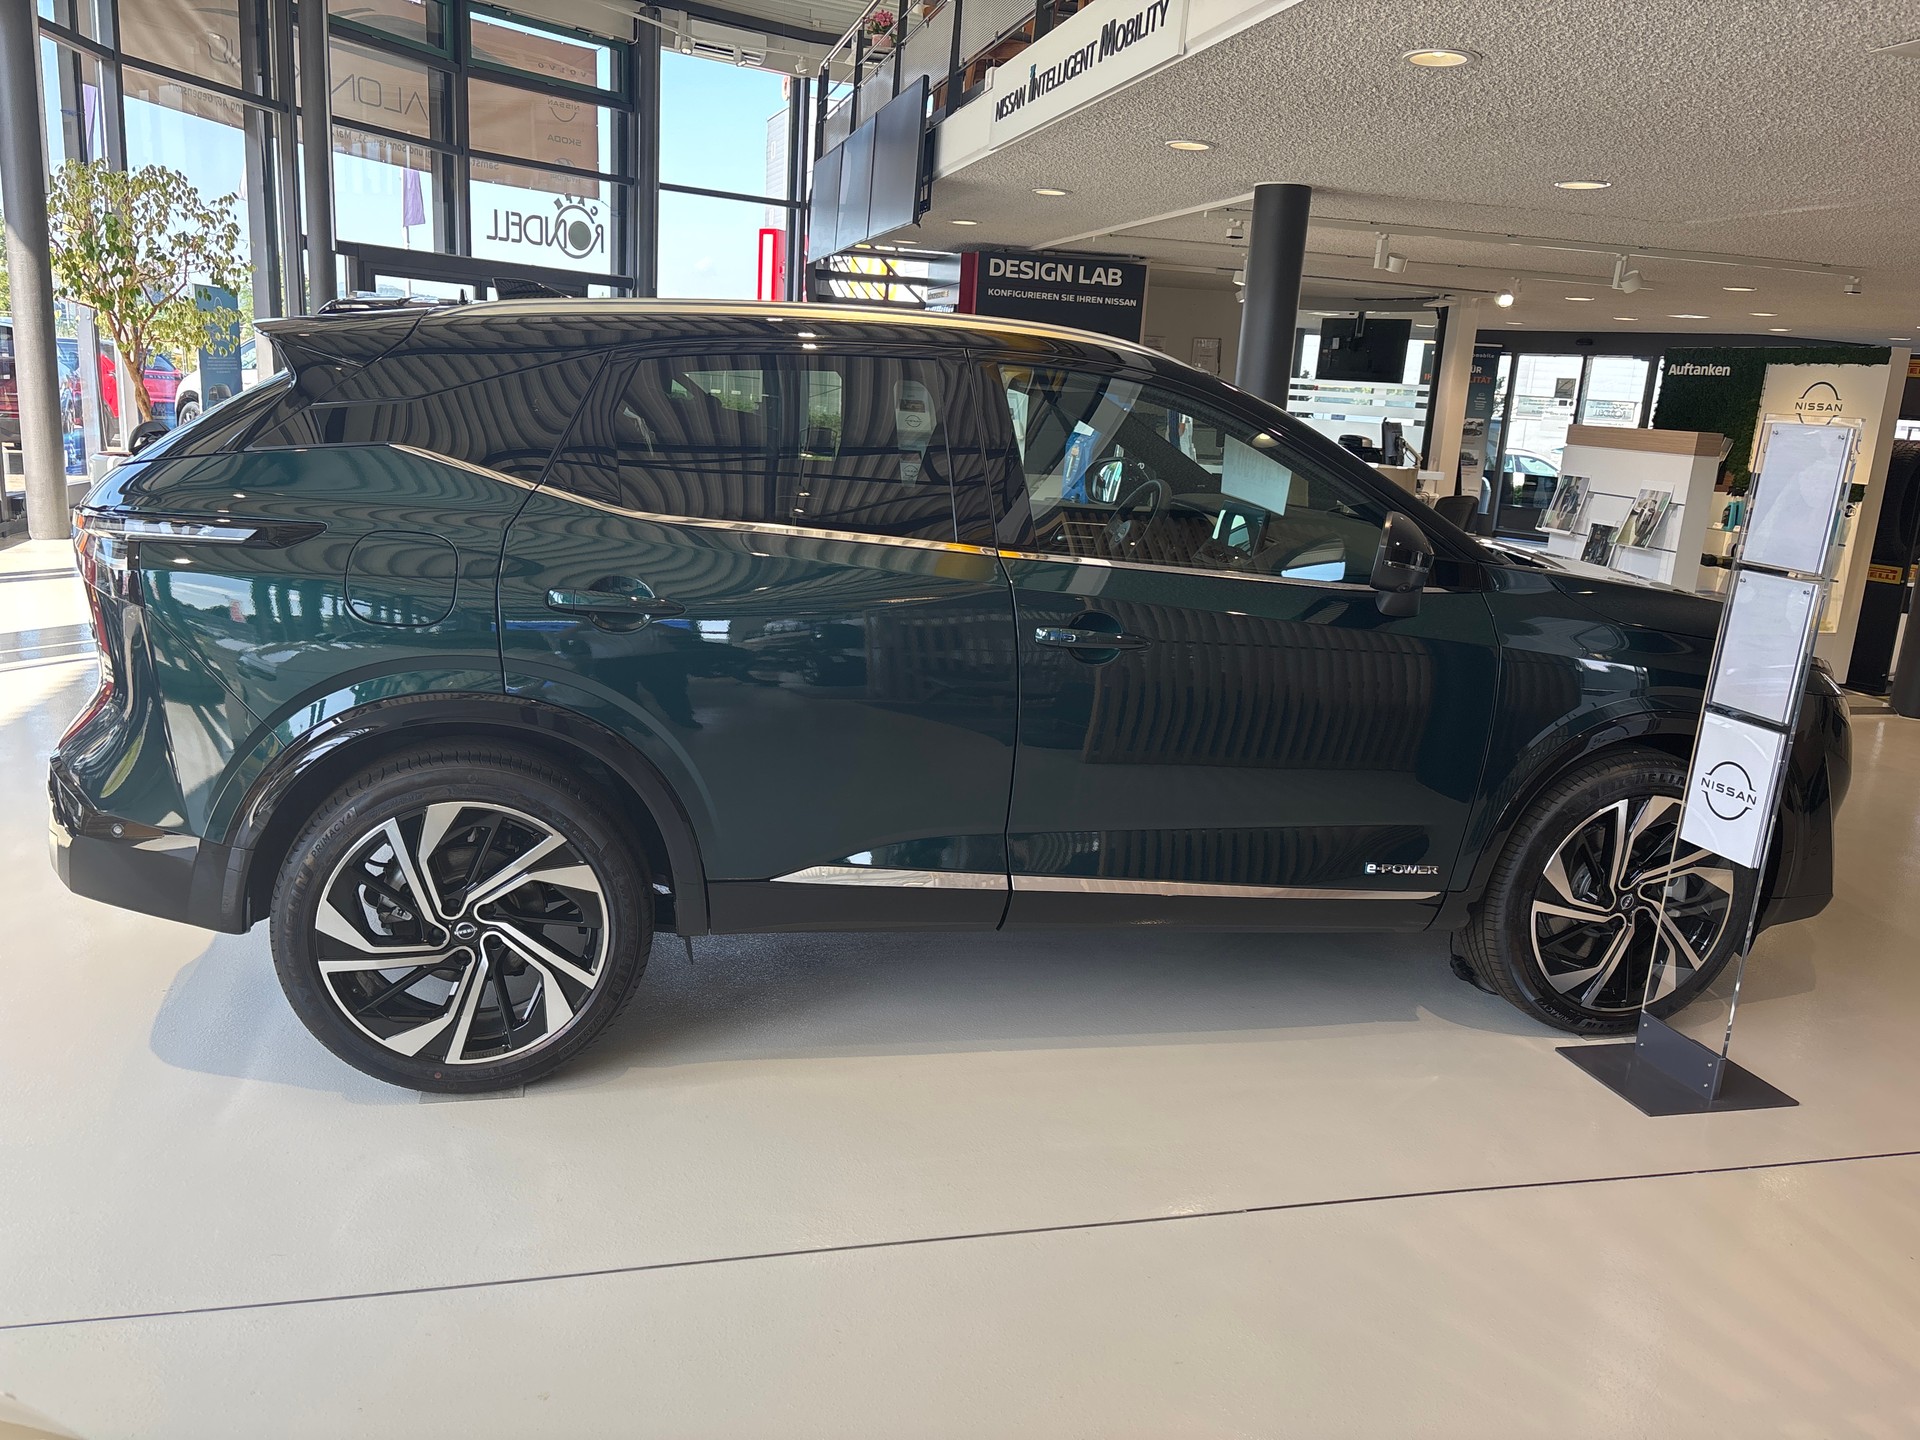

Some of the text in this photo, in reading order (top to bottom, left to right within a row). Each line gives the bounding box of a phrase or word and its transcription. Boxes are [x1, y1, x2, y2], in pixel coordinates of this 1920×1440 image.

[995, 0, 1169, 122] NISSAN INTELLIGENT MOBILITY
[988, 257, 1124, 287] DESIGN LAB
[987, 287, 1138, 308] KONFIGURIEREN SIE IHREN NISSAN
[1668, 362, 1731, 377] Auftanken
[1794, 401, 1844, 412] NISSAN
[1700, 776, 1757, 807] NISSAN
[311, 818, 347, 858] PRIMACY
[1365, 862, 1440, 875] e-POWER
